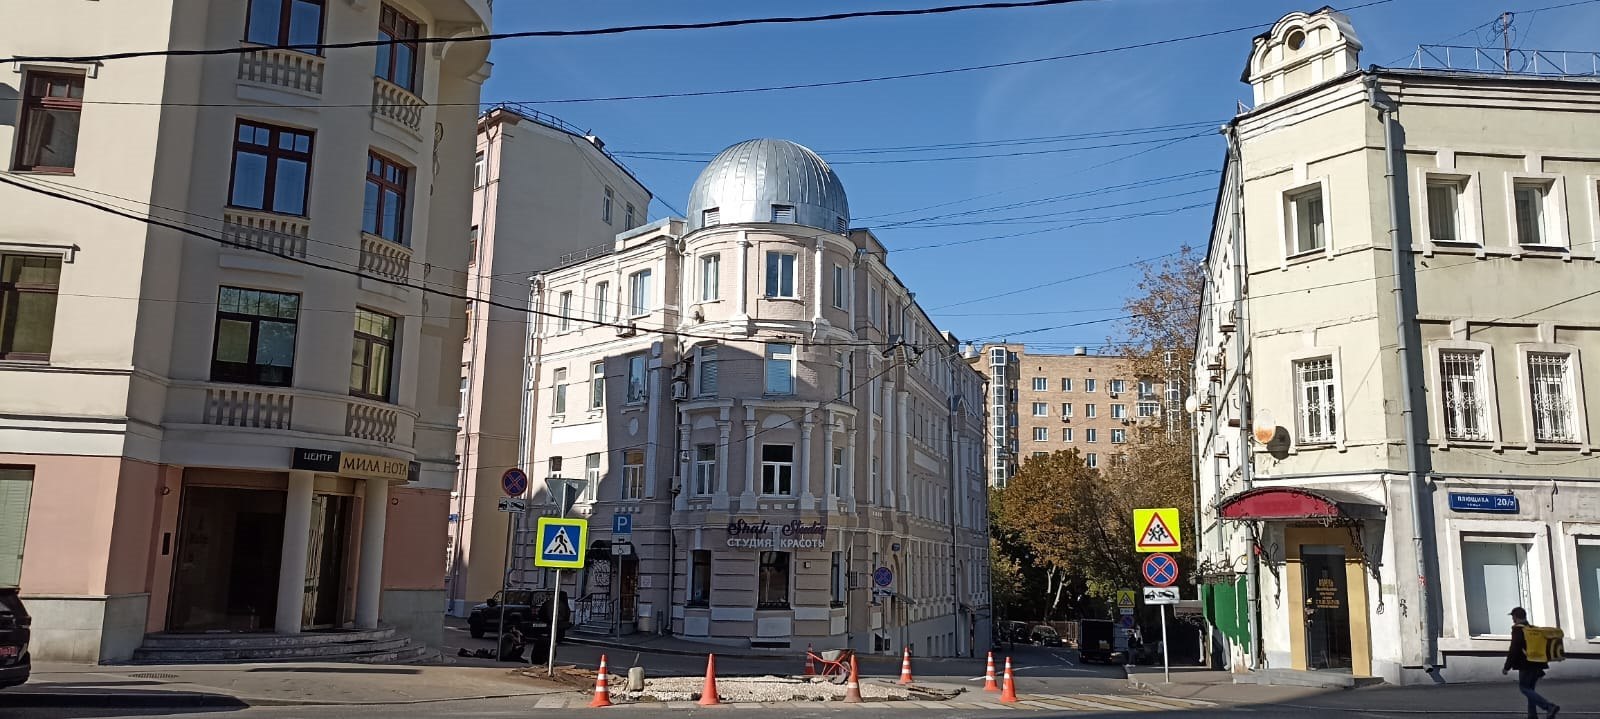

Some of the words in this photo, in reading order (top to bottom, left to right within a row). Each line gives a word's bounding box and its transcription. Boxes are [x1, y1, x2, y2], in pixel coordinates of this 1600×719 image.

[303, 452, 333, 462] ЦЕНТР
[343, 457, 380, 472] МИЛА
[383, 461, 407, 476] НОТА
[727, 538, 772, 549] СТУДИЯ
[780, 538, 825, 548] КРАСОТЫ
